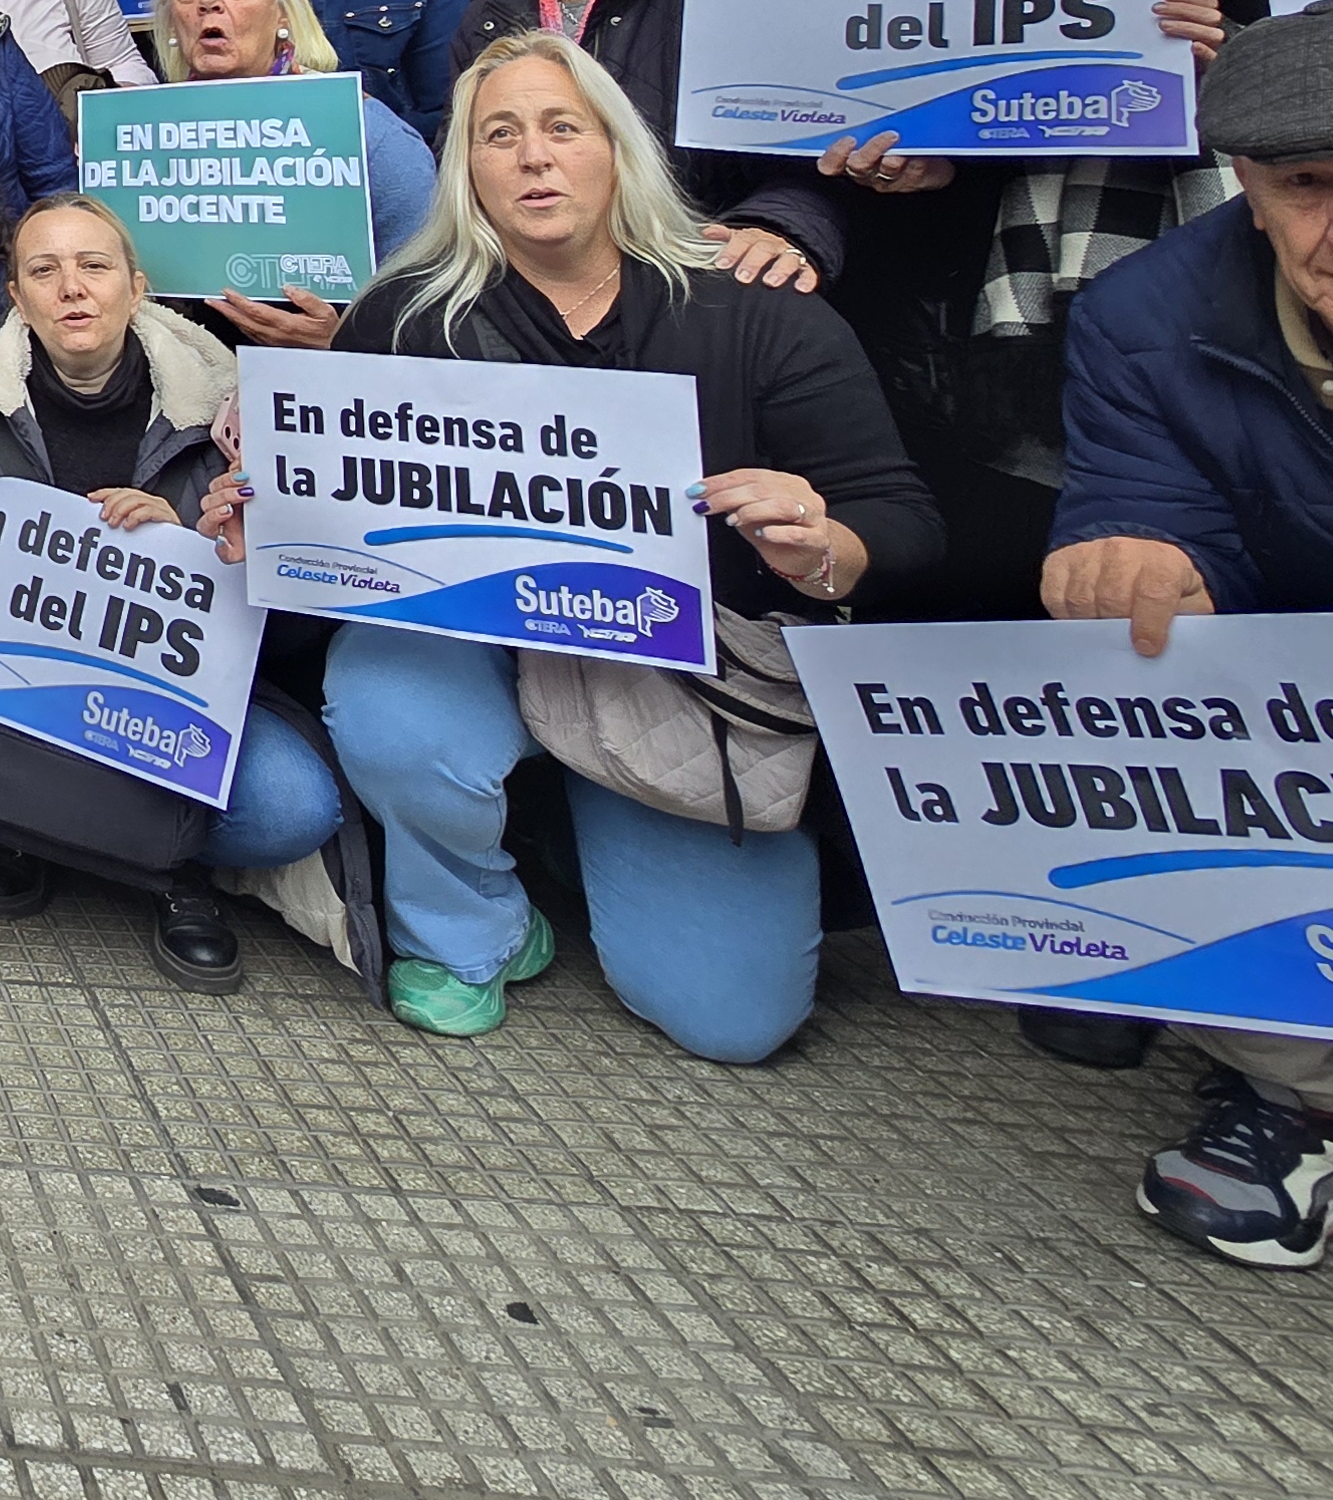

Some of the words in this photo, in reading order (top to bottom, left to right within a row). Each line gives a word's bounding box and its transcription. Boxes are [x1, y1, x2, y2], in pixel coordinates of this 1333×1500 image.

[845, 2, 949, 50] del
[780, 108, 847, 126] Violeta
[971, 88, 1109, 125] Suteba
[116, 123, 153, 152] EN
[158, 117, 312, 150] DEFENSA
[84, 160, 117, 188] DE
[121, 159, 160, 187] LA
[160, 147, 362, 188] JUBILACIÓN
[138, 194, 287, 224] DOCENTE
[280, 253, 353, 275] CTERA
[273, 392, 325, 435] En
[340, 398, 524, 454] defensa
[540, 414, 599, 460] de
[276, 455, 317, 498] la
[331, 455, 675, 537] JUBILACIÓN
[18, 510, 215, 614] defensa
[277, 563, 339, 586] Celeste
[339, 572, 401, 595] Violeta
[515, 574, 634, 626] Suteba
[9, 575, 87, 641] del
[98, 594, 205, 678] IPS
[82, 690, 176, 755] Suteba
[853, 682, 945, 736] En
[959, 682, 1252, 741] defensa
[885, 766, 960, 824] la
[931, 924, 1027, 951] Celeste
[1027, 933, 1130, 962] Violeta
